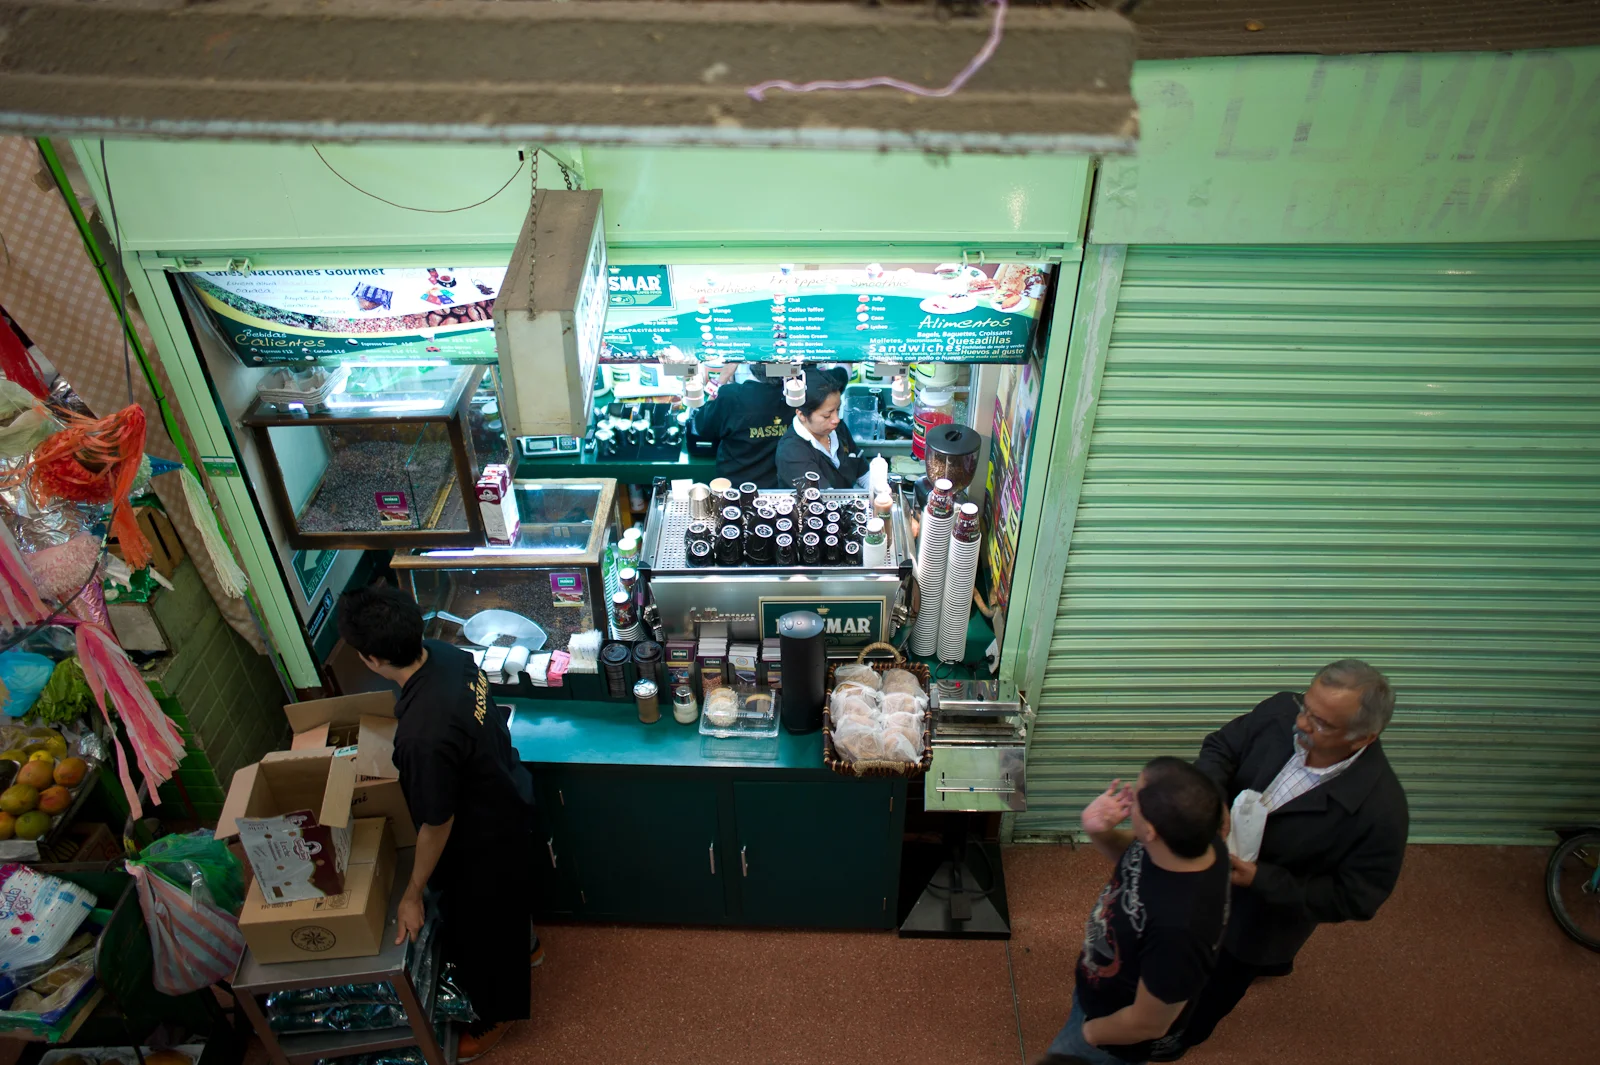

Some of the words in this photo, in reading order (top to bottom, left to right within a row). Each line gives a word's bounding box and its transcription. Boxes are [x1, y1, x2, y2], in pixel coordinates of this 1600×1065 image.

[917, 314, 1012, 330] Alimentos
[242, 329, 287, 338] Bebidas
[942, 330, 977, 338] Baguettes,
[978, 329, 1014, 337] Croissants
[235, 333, 326, 348] Calientes
[946, 336, 1011, 346] Quesadillas
[868, 343, 962, 353] Sandwiches
[1001, 348, 1024, 357] gusto
